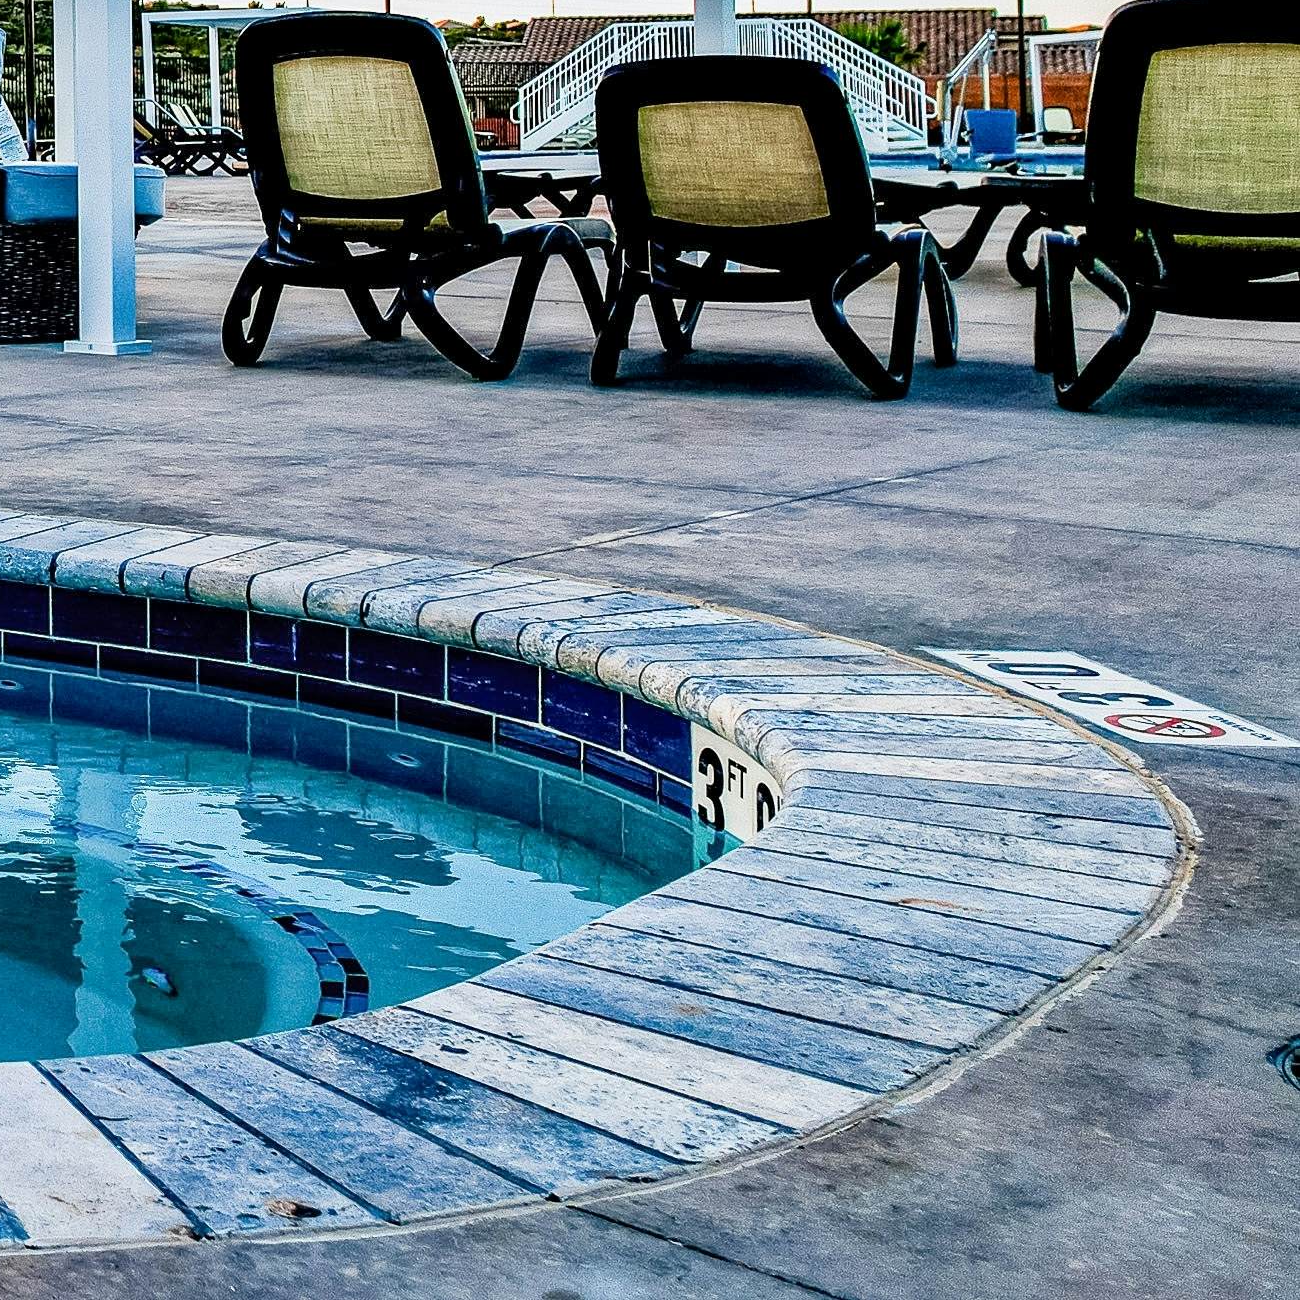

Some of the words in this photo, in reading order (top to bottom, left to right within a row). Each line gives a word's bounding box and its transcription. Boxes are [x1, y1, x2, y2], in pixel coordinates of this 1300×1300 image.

[957, 653, 1005, 662] IN
[987, 662, 1101, 677] 0
[1021, 680, 1077, 691] FT
[1057, 691, 1175, 707] 3
[697, 747, 725, 832] 3
[727, 758, 748, 799] FT
